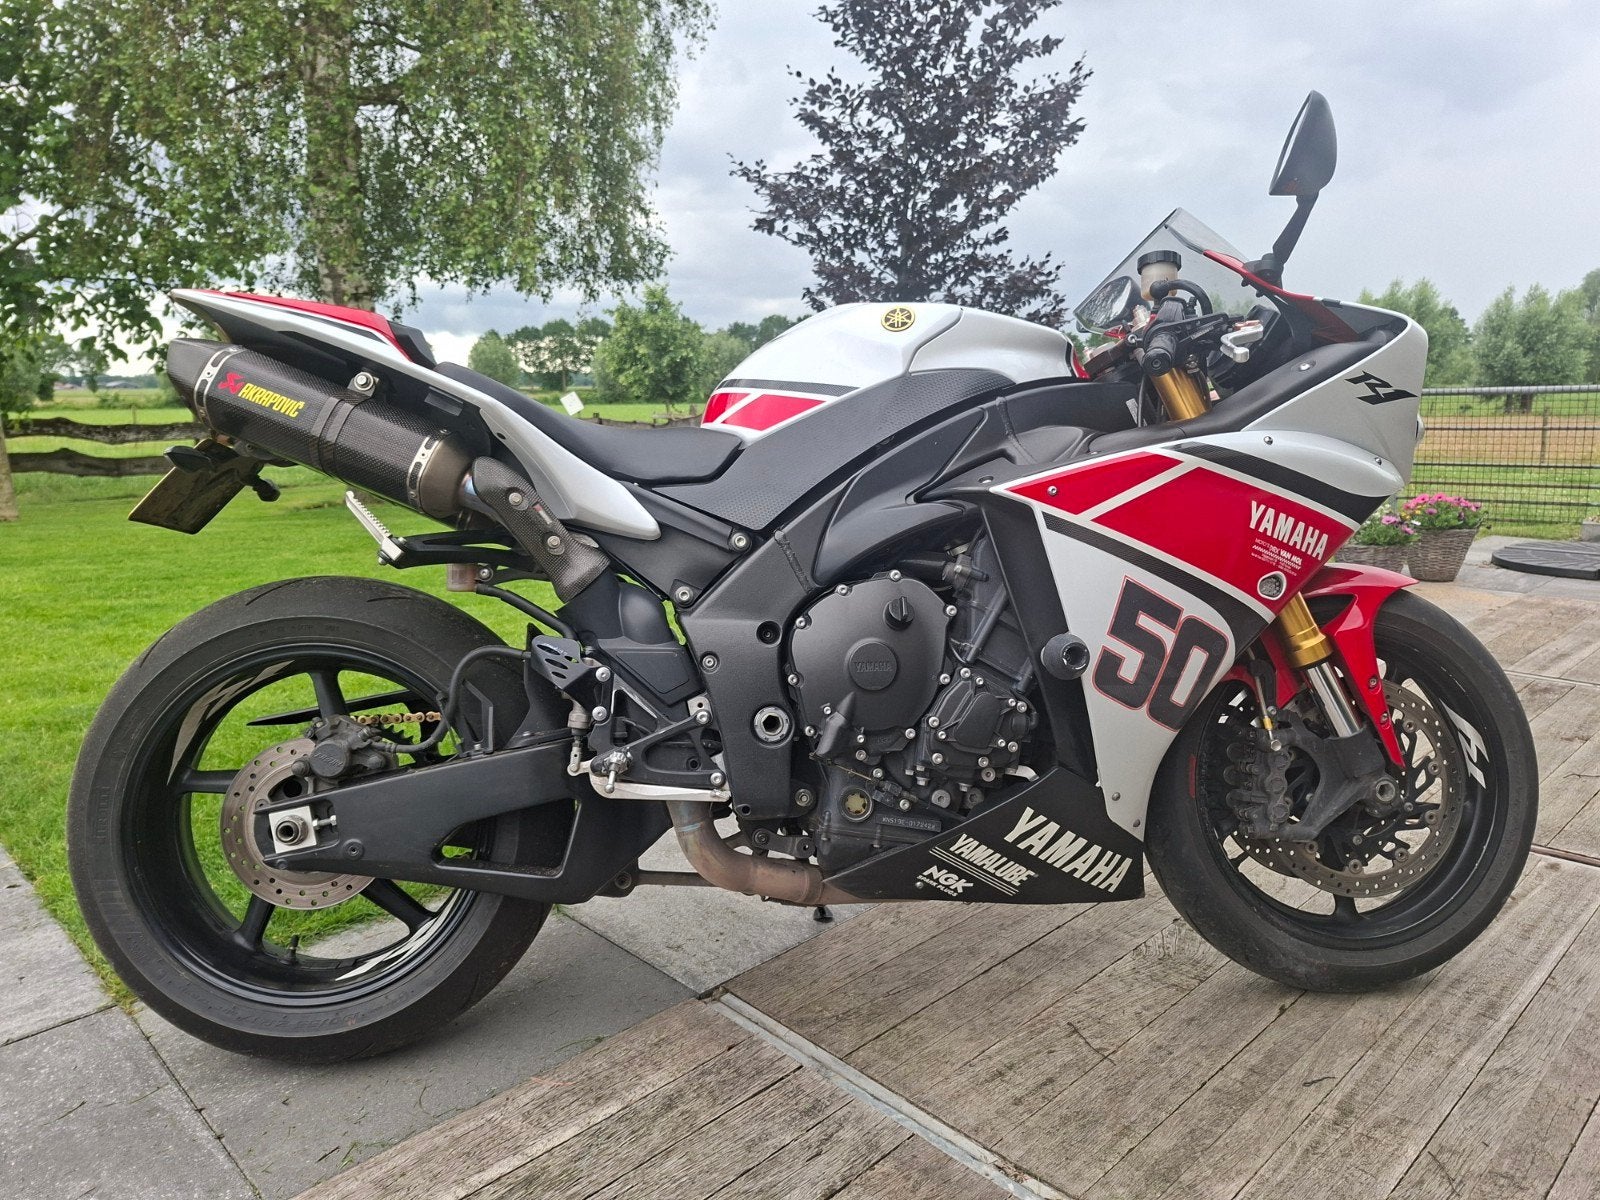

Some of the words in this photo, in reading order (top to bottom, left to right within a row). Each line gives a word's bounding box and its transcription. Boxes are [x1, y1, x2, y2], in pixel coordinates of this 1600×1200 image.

[1344, 370, 1418, 405] R1
[1249, 500, 1329, 561] YAMAHA
[854, 661, 893, 673] YAMAHA
[1092, 575, 1230, 732] 50
[949, 833, 1036, 887] YAMALUBE
[1003, 806, 1133, 893] YAMAHA
[917, 874, 938, 887] SPARK
[937, 884, 958, 897] PLUGS
[922, 865, 974, 893] NGK
